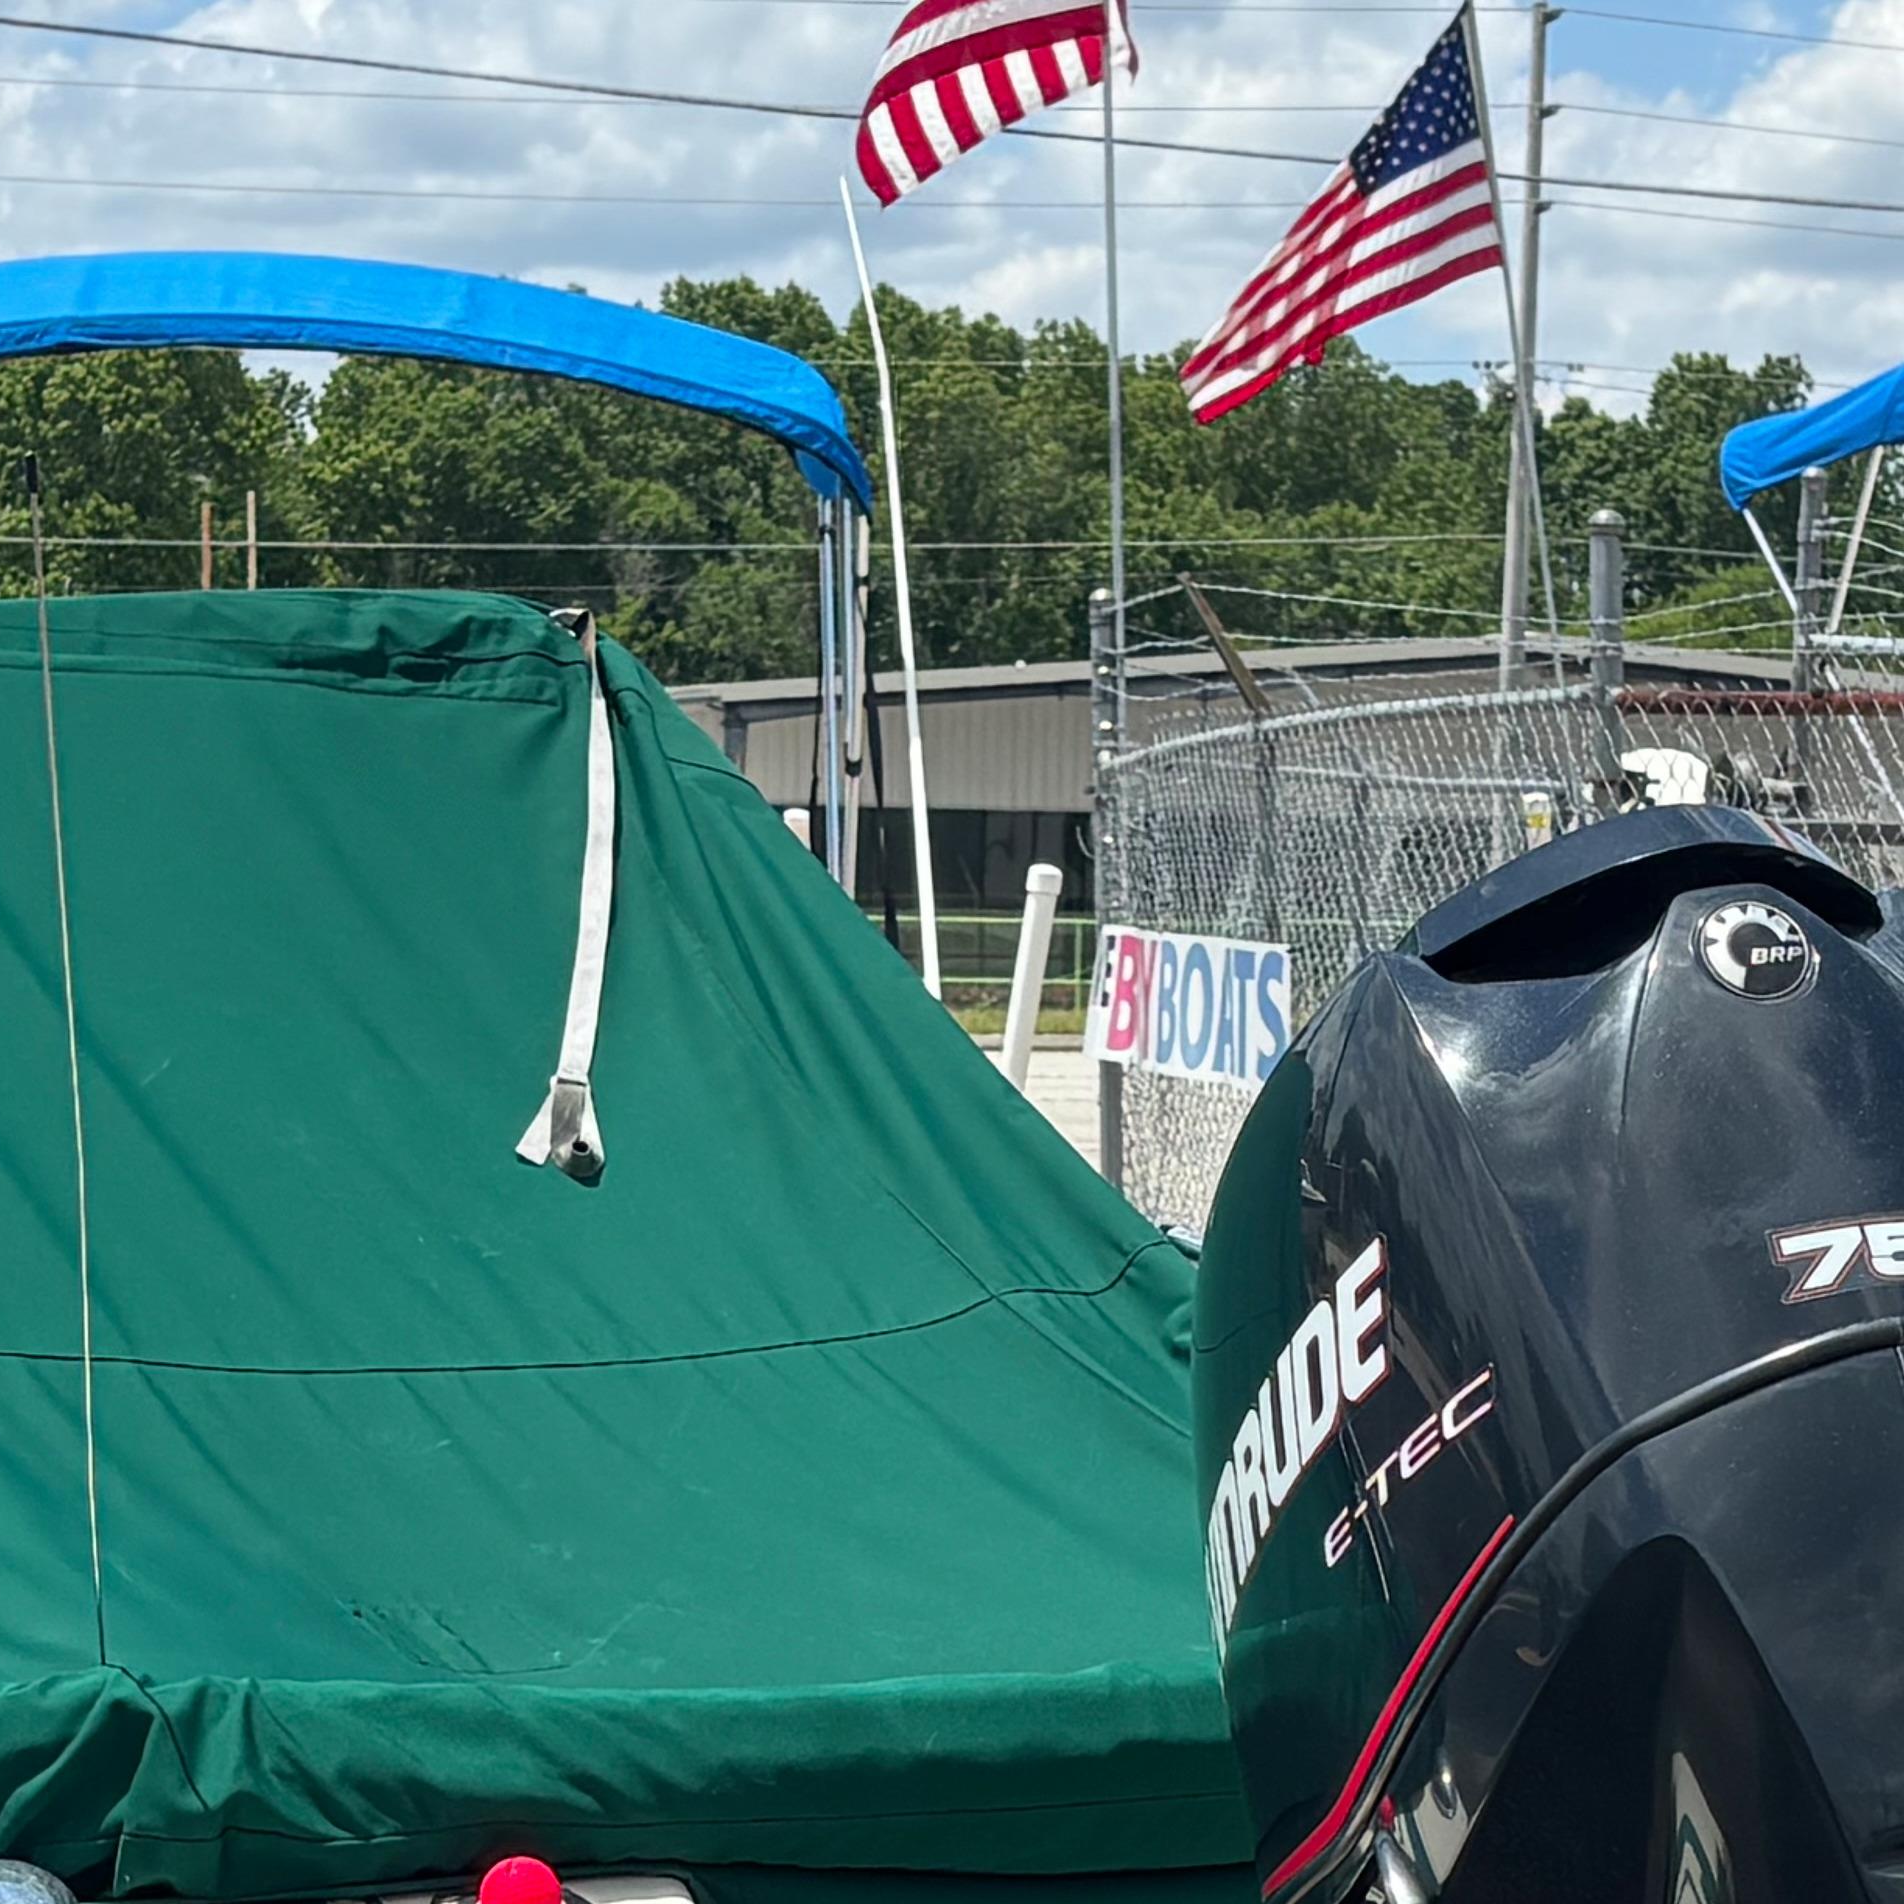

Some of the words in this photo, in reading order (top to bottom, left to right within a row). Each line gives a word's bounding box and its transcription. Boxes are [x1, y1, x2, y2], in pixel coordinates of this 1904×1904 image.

[1156, 940, 1287, 1081] BOATS
[1750, 945, 1803, 965] BRP
[1324, 1363, 1495, 1568] E-TEC
